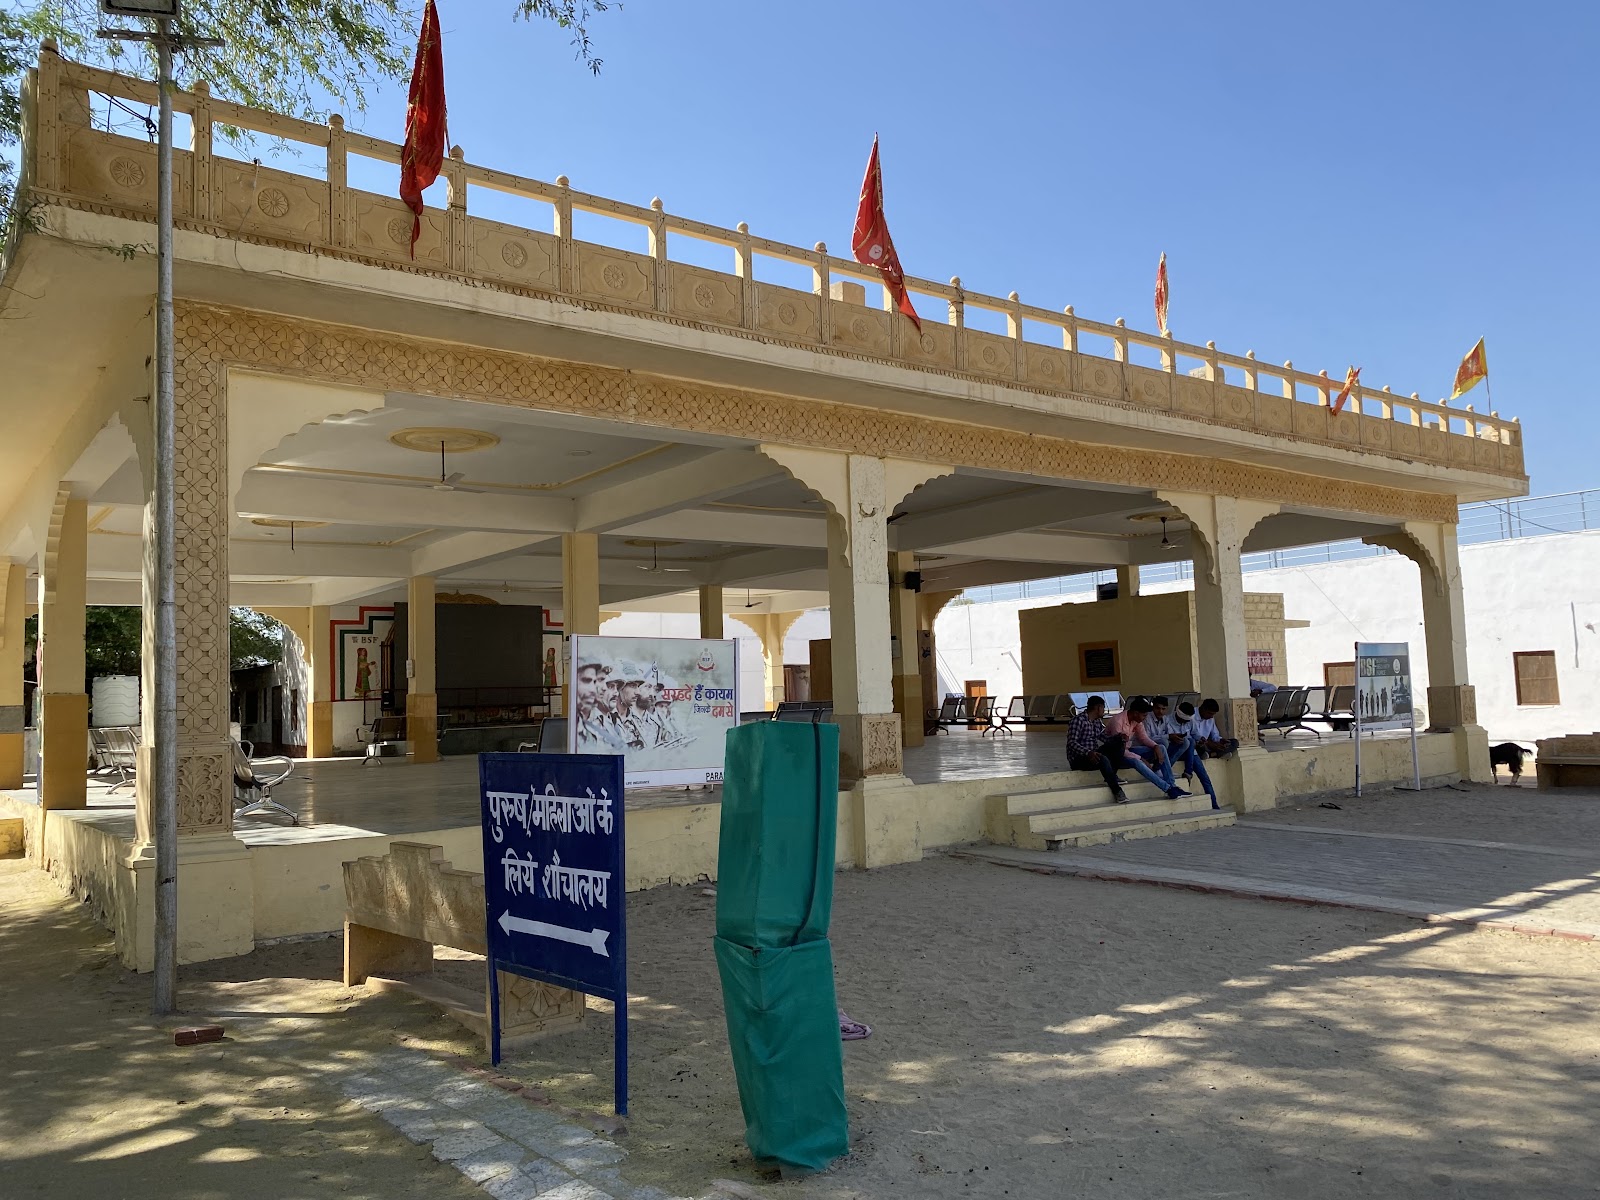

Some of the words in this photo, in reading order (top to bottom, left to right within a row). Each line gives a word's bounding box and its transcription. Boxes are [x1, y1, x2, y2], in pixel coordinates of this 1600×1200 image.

[704, 688, 733, 700] कायम
[596, 787, 613, 835] के
[501, 847, 539, 896] लिये
[542, 849, 611, 911] शौचालय
